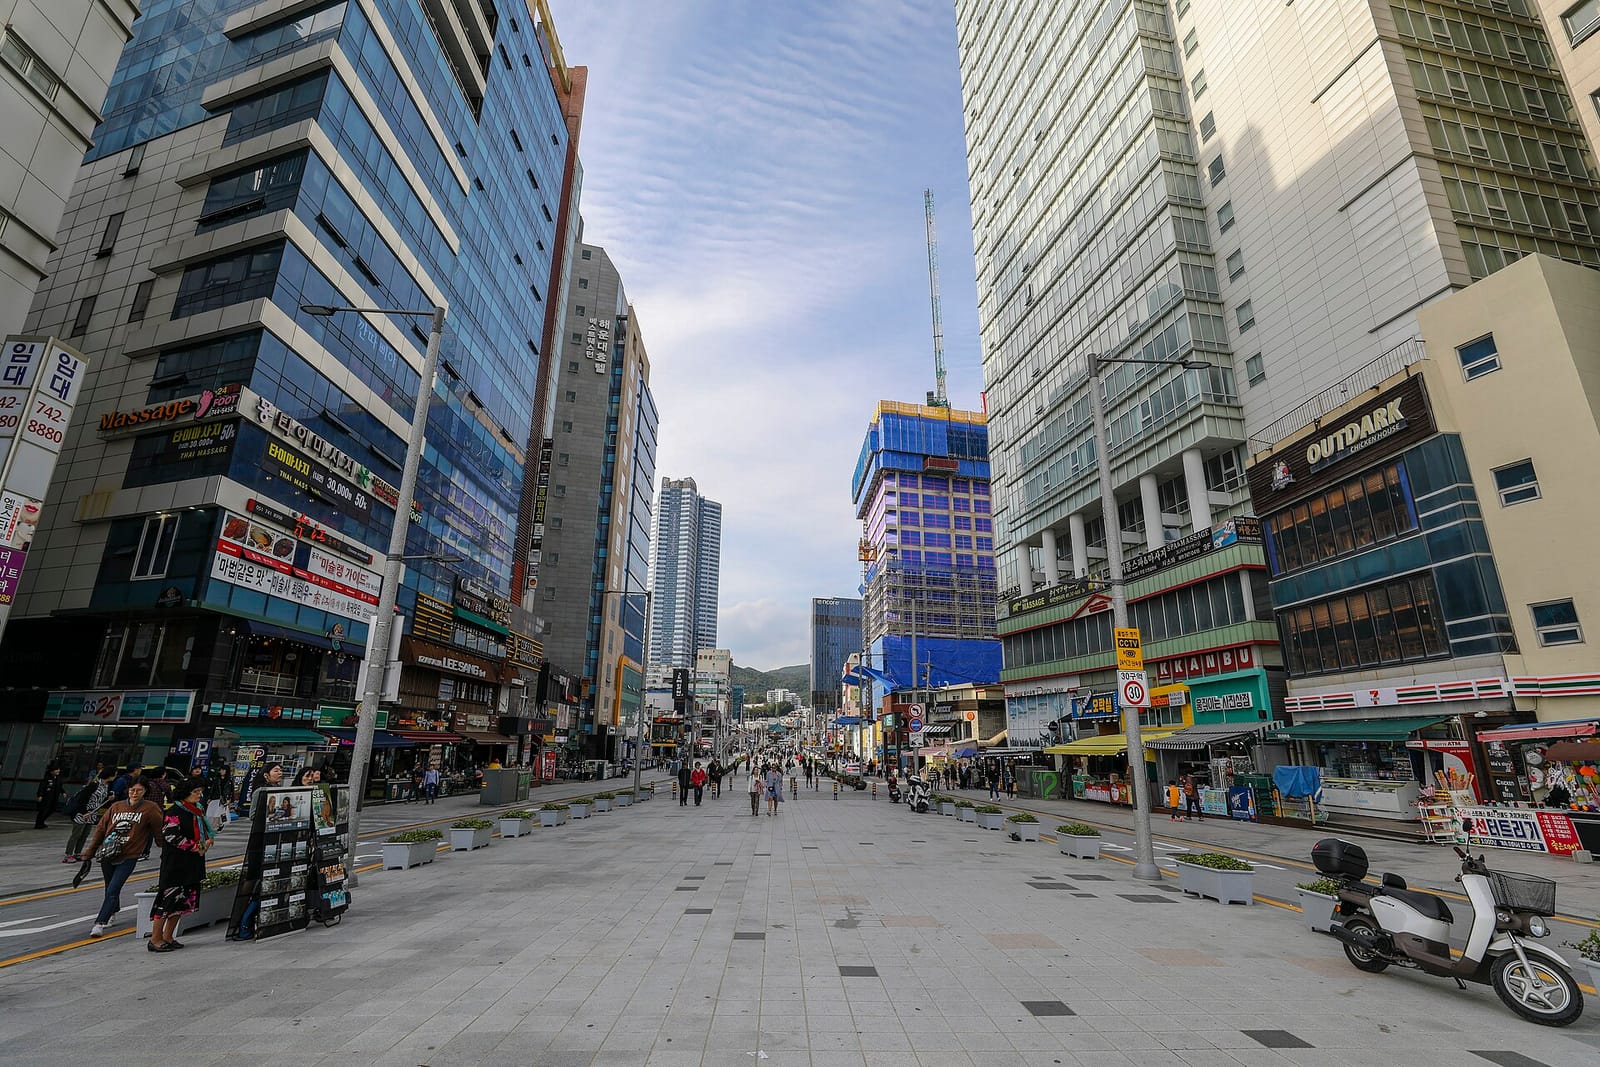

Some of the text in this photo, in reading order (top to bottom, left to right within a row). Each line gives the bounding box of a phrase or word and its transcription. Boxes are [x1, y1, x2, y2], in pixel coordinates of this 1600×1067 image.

[595, 319, 610, 374] 해운대호텔
[3, 343, 35, 386] 임대
[49, 352, 79, 401] 임대
[36, 400, 66, 423] 742-
[213, 394, 237, 407] FOOT
[100, 399, 192, 429] Massage
[27, 419, 63, 443] 8880
[172, 422, 222, 443] 타이마사지
[1306, 397, 1404, 465] OUTDARK
[1350, 423, 1401, 454] CHICKEN HOUSE
[268, 442, 311, 477] 타이마사지
[279, 469, 293, 482] THAI
[1020, 597, 1046, 611] MASSAGE
[1118, 639, 1138, 648] CCTV
[1160, 648, 1250, 676] KKANBU
[1128, 686, 1140, 699] 30
[1222, 692, 1251, 710] 사진상점
[82, 695, 122, 719] GS25
[178, 740, 189, 752] P
[197, 741, 209, 758] P
[254, 749, 265, 761] P
